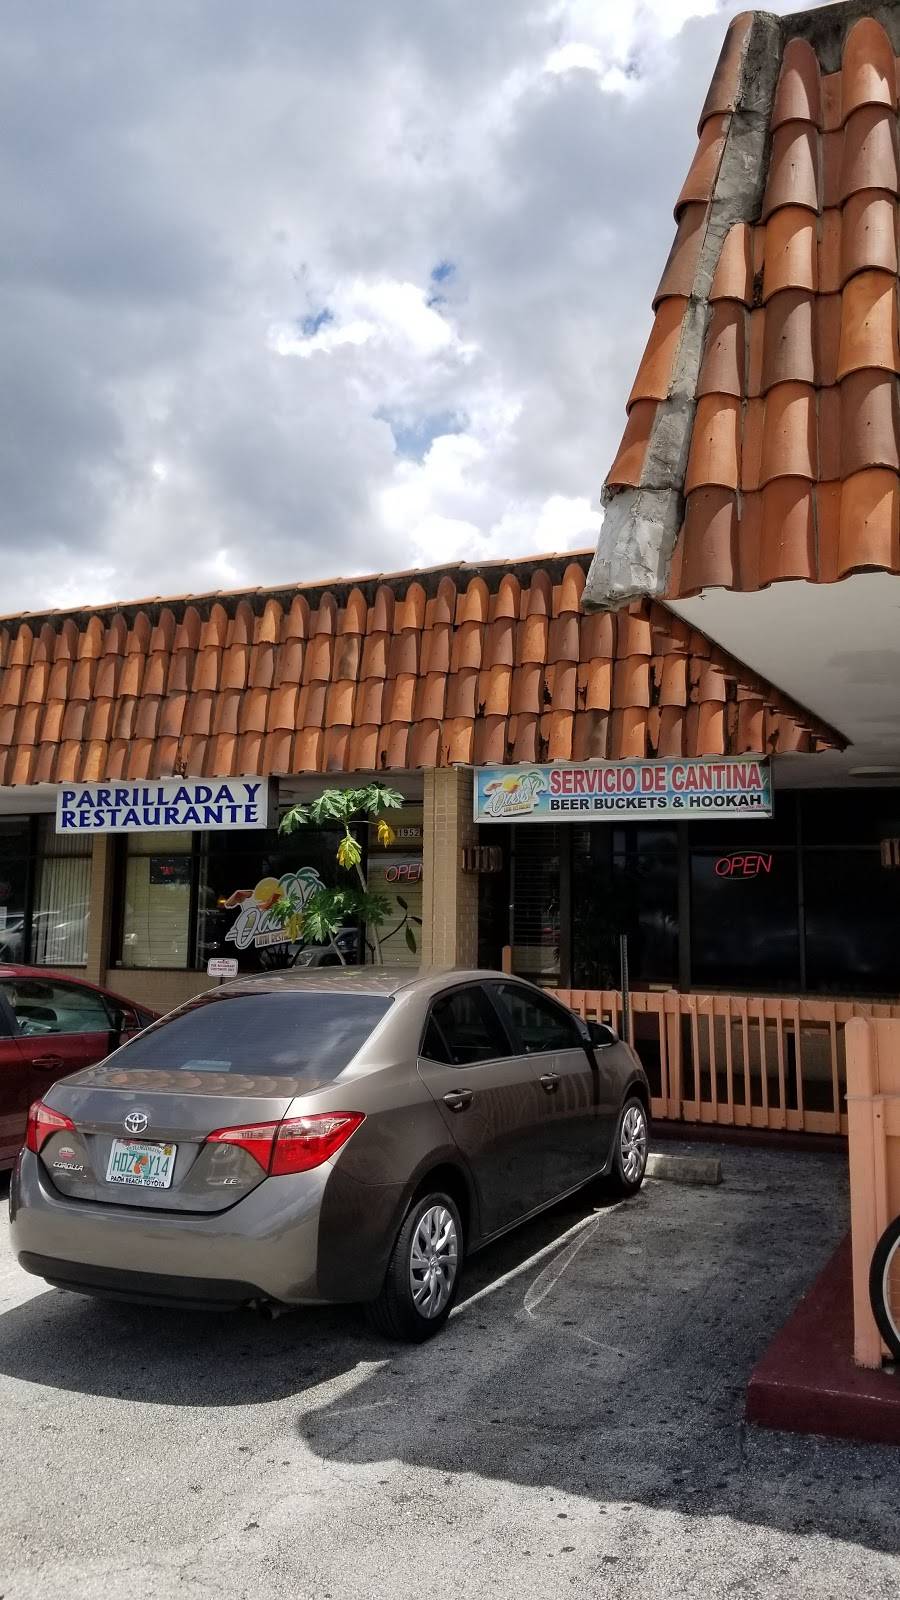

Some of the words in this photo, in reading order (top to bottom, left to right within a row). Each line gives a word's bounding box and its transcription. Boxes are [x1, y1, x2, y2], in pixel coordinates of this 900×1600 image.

[550, 768, 636, 794] SERVICIO
[641, 767, 666, 791] DE
[671, 764, 762, 791] CANTINA
[61, 784, 235, 809] PARRILLADA
[242, 783, 262, 802] Y
[550, 798, 590, 810] BEER
[594, 796, 667, 810] BUCKETS
[672, 795, 684, 808] &
[689, 794, 761, 808] HOOKAH
[61, 804, 259, 828] RESTAURANTE
[715, 855, 772, 875] OPEN
[53, 1161, 83, 1171] COROLLA
[143, 1179, 165, 1187] TOYOTA
